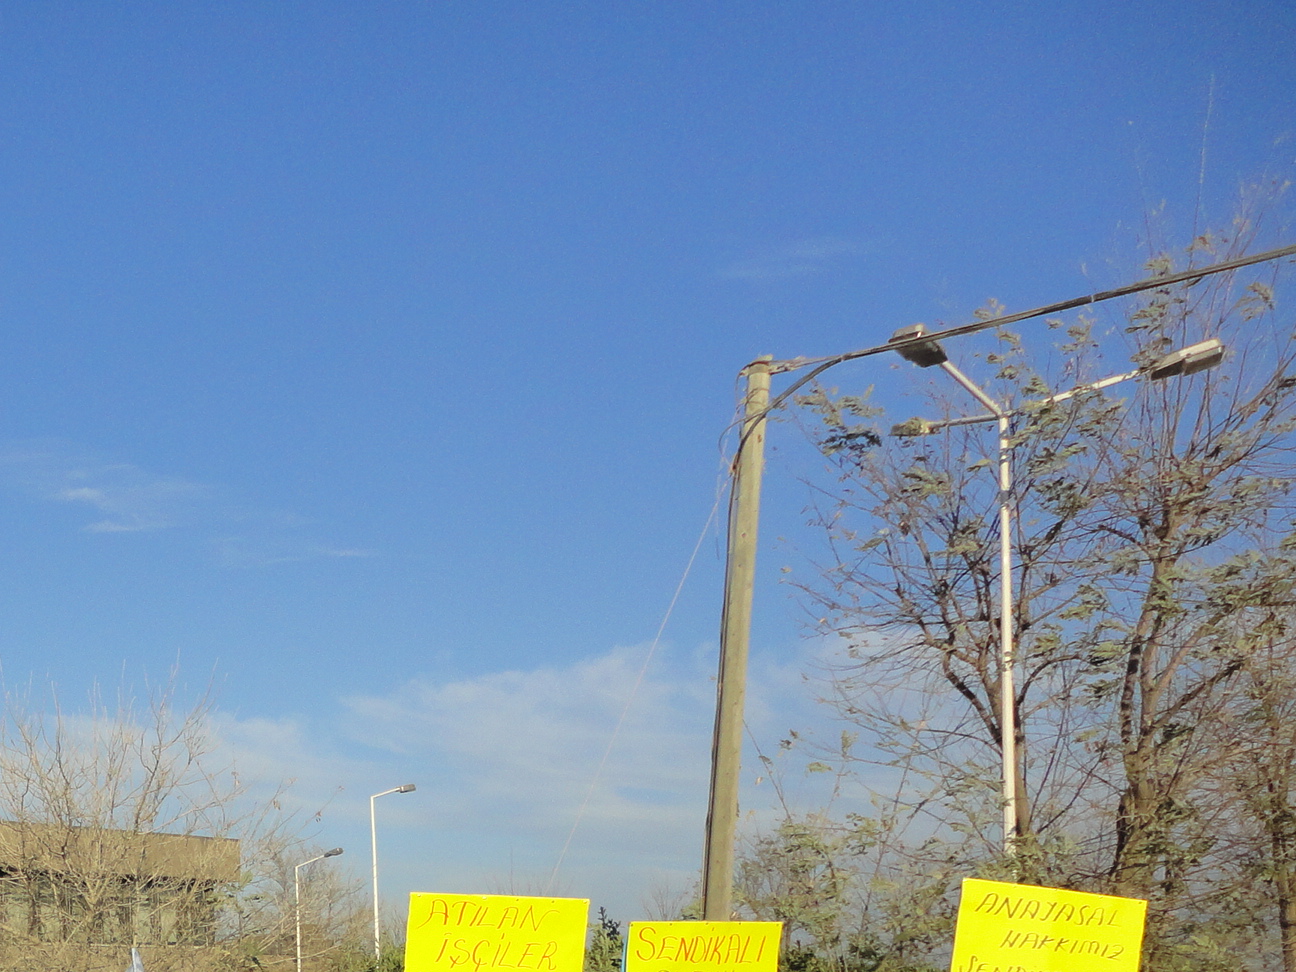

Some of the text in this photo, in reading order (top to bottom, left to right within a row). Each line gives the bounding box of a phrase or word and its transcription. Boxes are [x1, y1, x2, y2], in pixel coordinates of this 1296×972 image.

[416, 898, 561, 932] ATILAN
[974, 892, 1121, 928] ANAYASAL
[435, 932, 559, 972] İŞÇİLER
[636, 926, 767, 966] SENDİKALI
[1000, 929, 1125, 961] HAKKIMIZ
